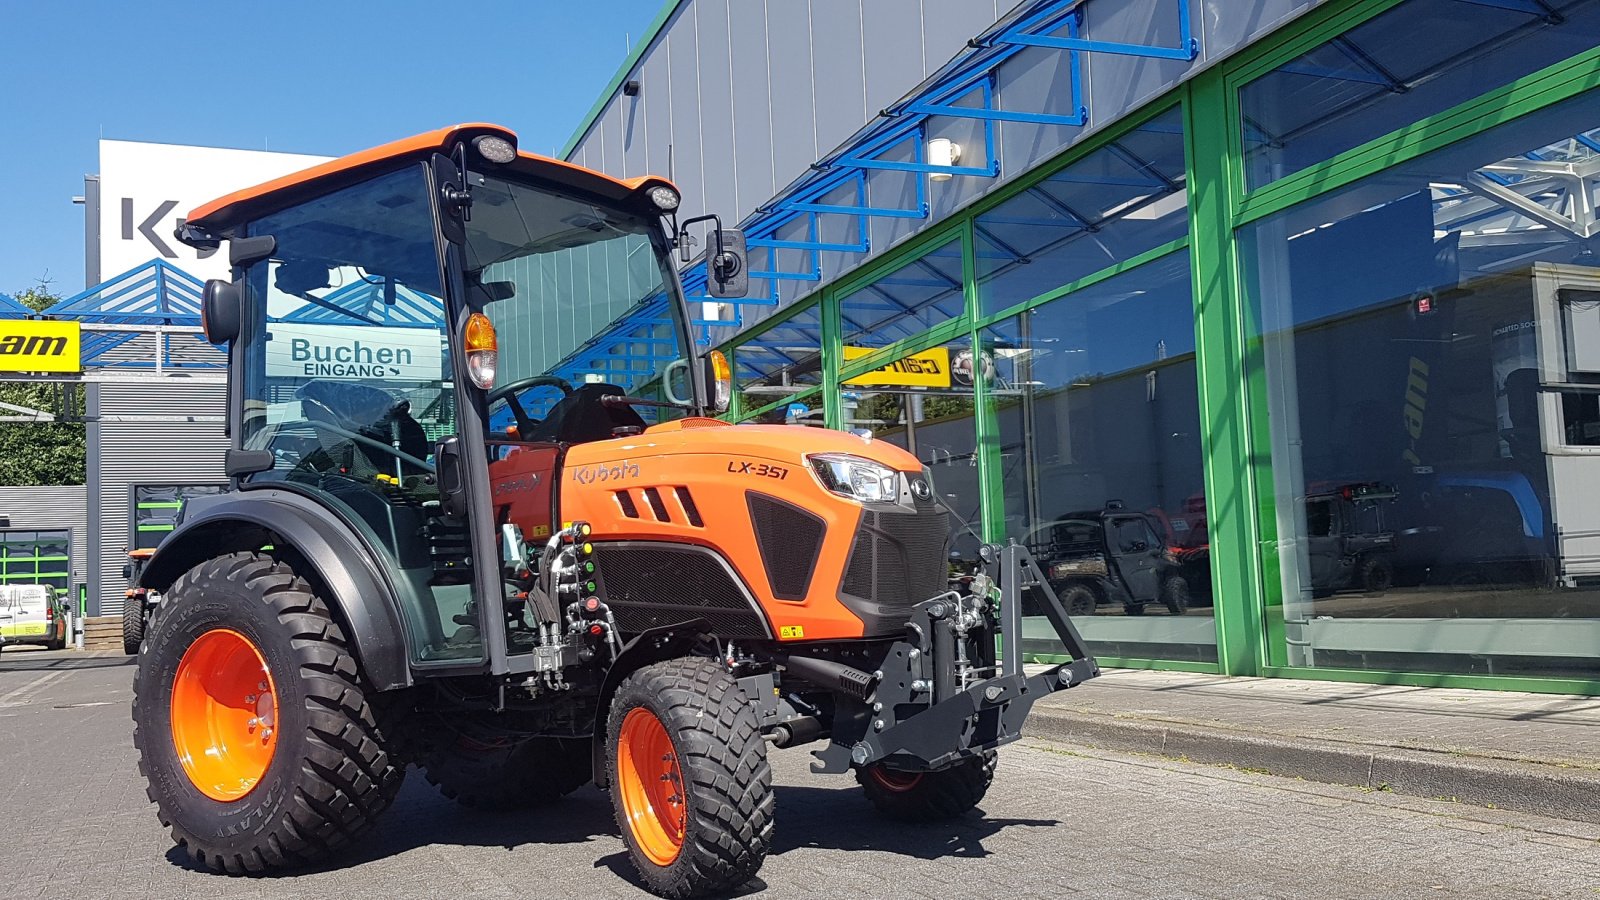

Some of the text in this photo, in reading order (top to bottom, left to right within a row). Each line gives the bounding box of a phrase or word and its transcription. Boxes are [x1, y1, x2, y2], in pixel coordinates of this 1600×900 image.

[291, 338, 412, 364] Buchen
[304, 363, 385, 377] EINGANG
[573, 459, 640, 485] Kubota
[727, 461, 789, 480] LX-351
